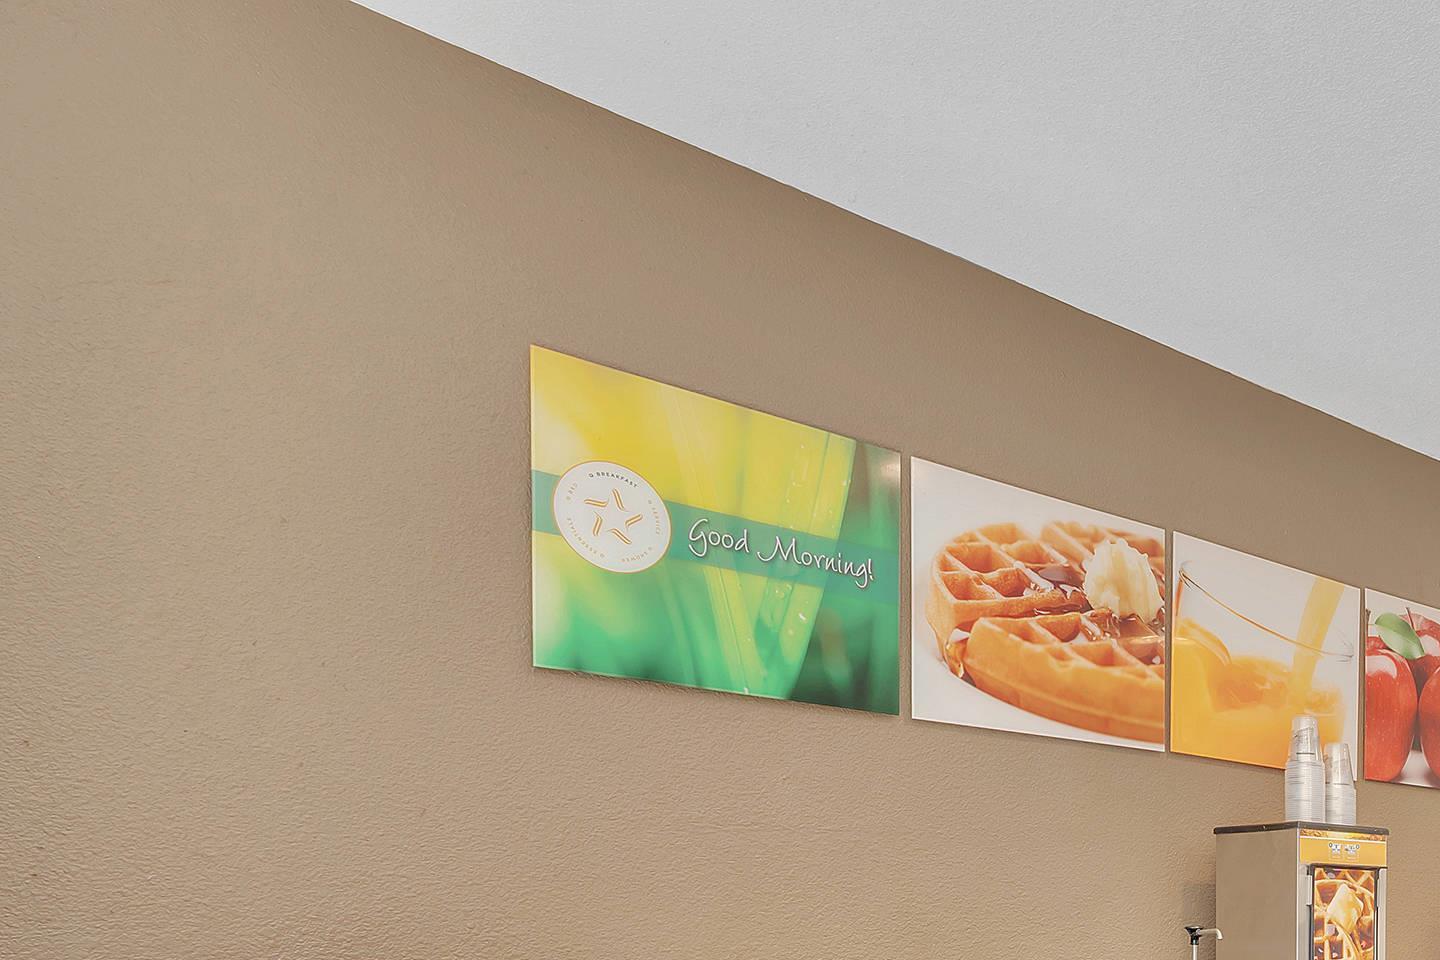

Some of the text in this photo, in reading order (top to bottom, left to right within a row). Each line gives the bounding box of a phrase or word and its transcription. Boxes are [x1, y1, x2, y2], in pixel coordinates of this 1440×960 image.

[596, 471, 639, 489] BREAKFAST
[688, 518, 875, 588] Good Morning!
